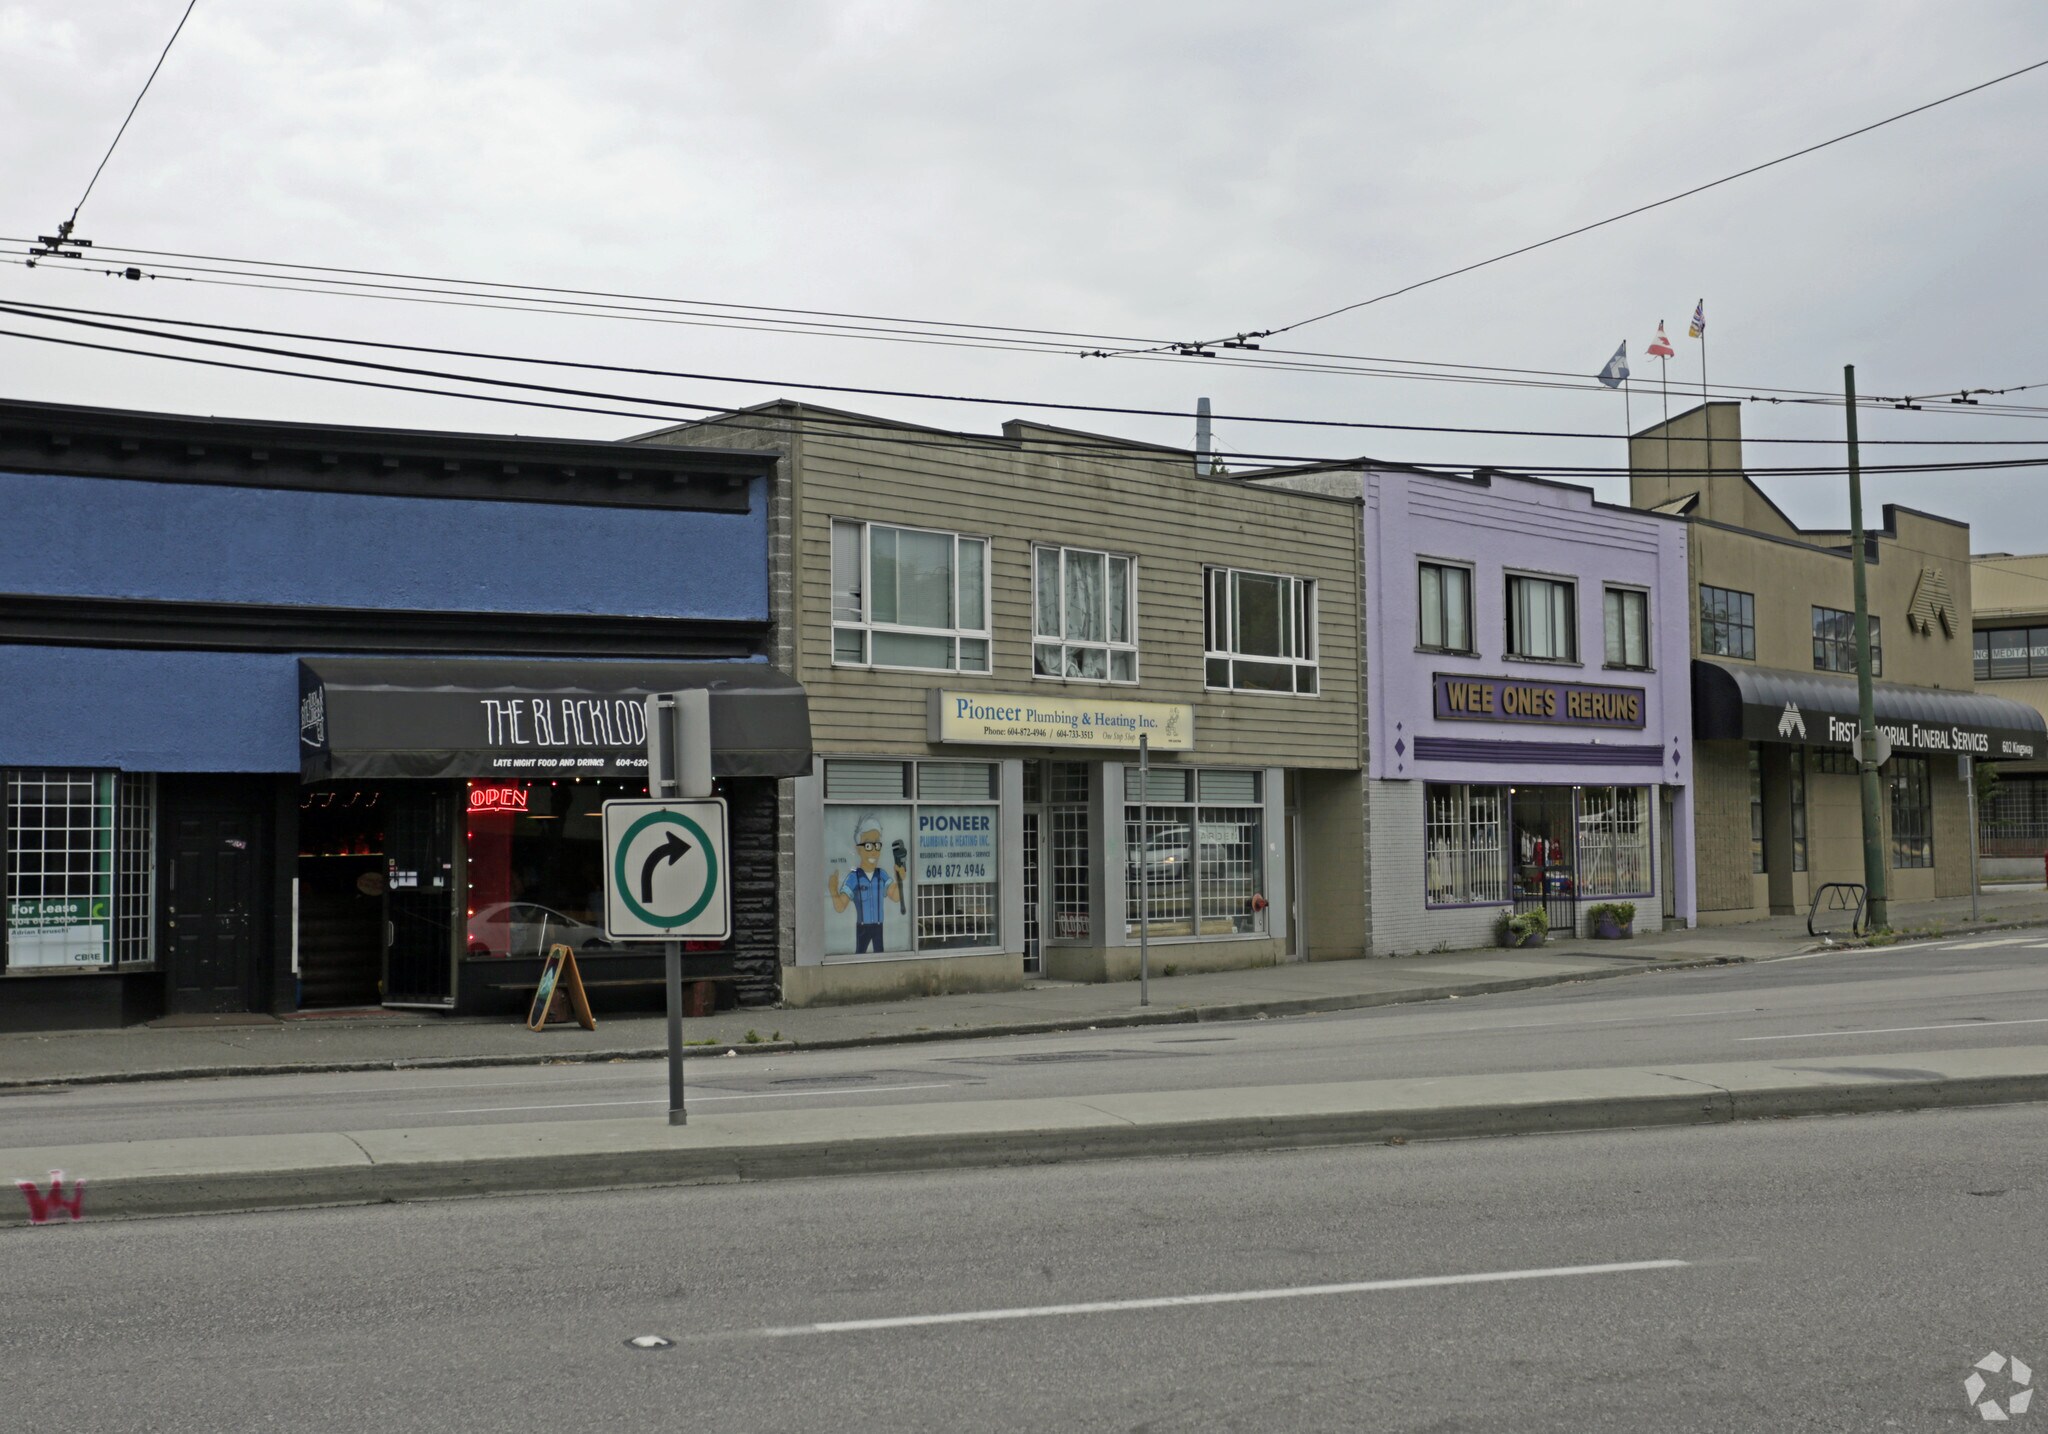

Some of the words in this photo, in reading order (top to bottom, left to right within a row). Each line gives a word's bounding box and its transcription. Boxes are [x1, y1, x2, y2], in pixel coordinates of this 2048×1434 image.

[1446, 682, 1494, 712] WEE
[1502, 685, 1556, 716] ONES
[1567, 690, 1639, 721] RERUNS
[956, 698, 1021, 721] Pioneer
[1026, 709, 1078, 728] Plumbing
[1082, 713, 1091, 725] &
[1095, 712, 1136, 731] Heating
[1139, 714, 1158, 728] Inc.
[480, 700, 530, 745] THE
[532, 699, 648, 746] BLACKLOD
[984, 726, 1006, 736] Phone:
[1007, 728, 1047, 737] 604-872-4946
[1056, 729, 1094, 739] 604-733-3513
[2002, 741, 2012, 753] 602
[2012, 742, 2034, 757] Kingsway
[493, 759, 512, 767] LATE
[513, 759, 536, 767] NIGHT
[537, 759, 557, 767] FOOD
[559, 759, 575, 767] AND
[577, 758, 605, 767] DRINKS
[470, 789, 527, 806] OPEN
[919, 816, 990, 831] PIONEER
[920, 835, 948, 848] PLUMBING
[949, 835, 954, 847] &
[954, 834, 978, 847] HEATING
[926, 865, 942, 878] 604
[945, 864, 961, 877] 872
[964, 863, 985, 876] 4946
[11, 904, 35, 915] For
[38, 903, 78, 914] Lease
[74, 953, 101, 961] CBRE
